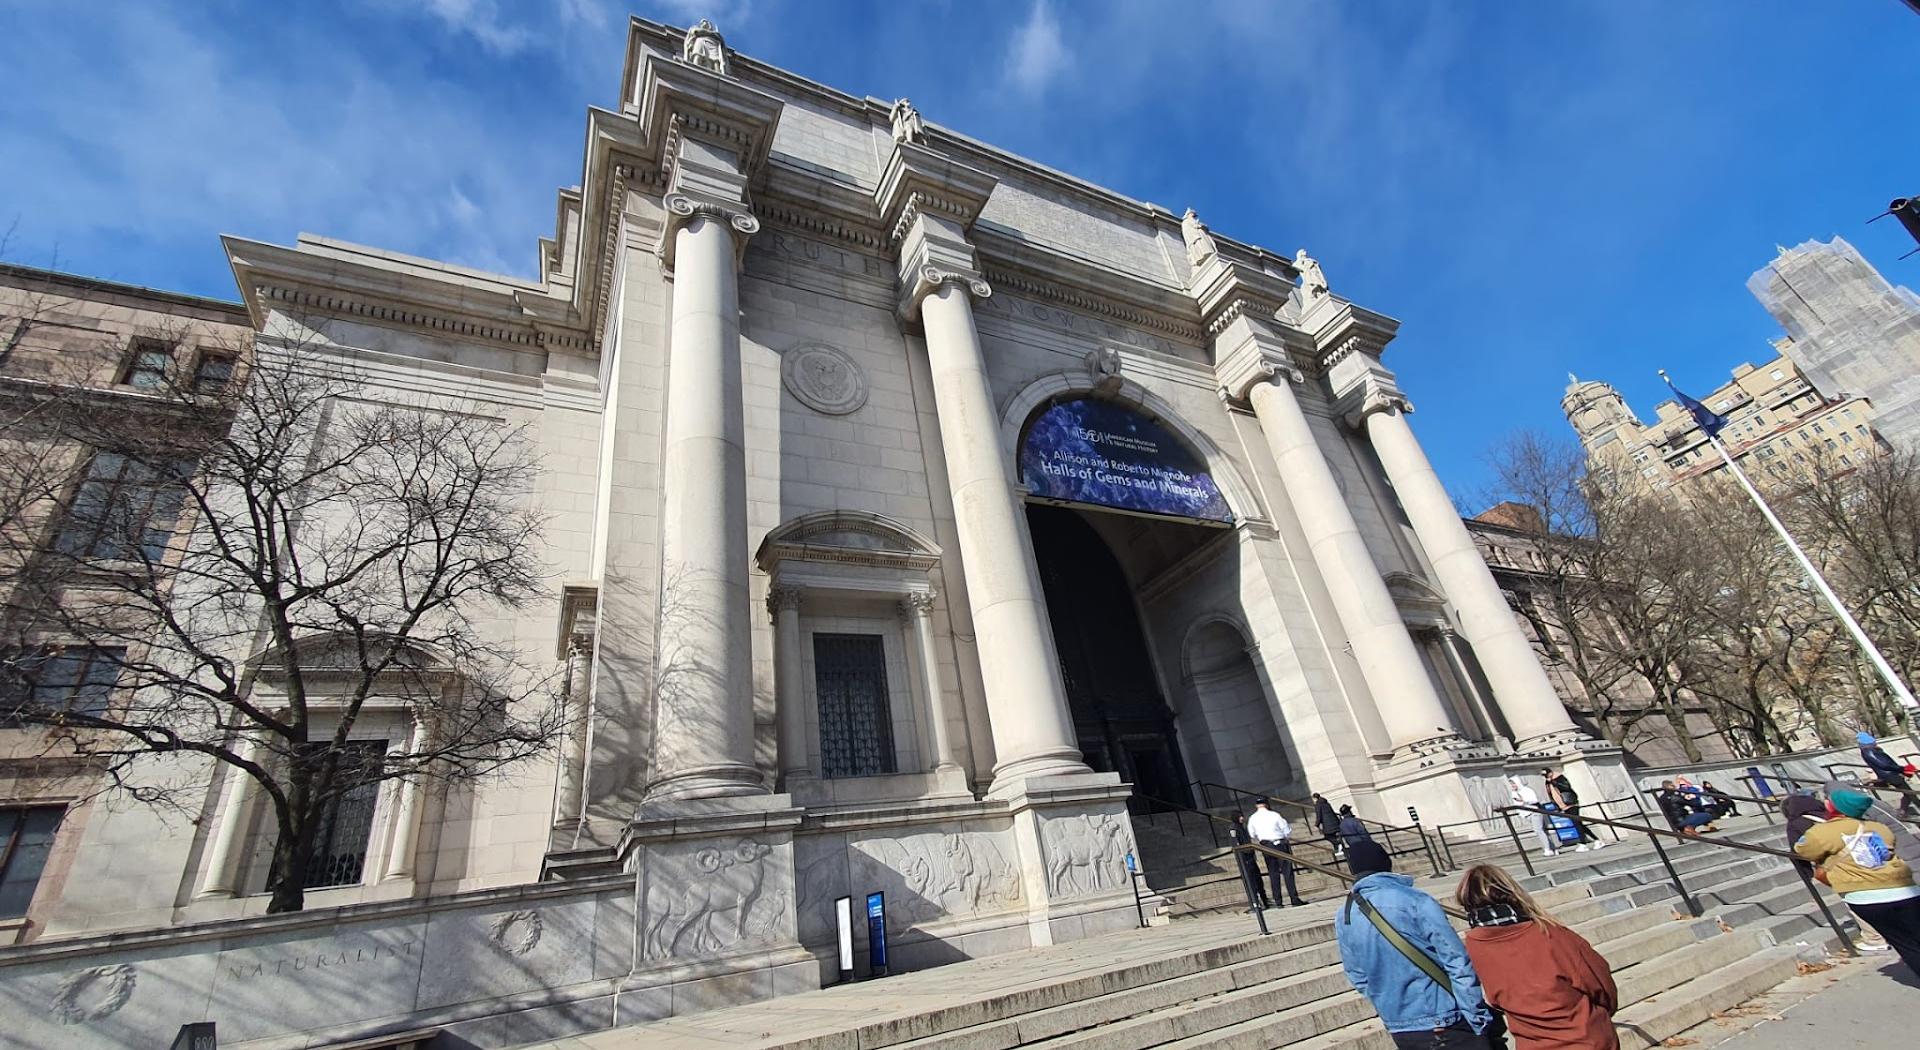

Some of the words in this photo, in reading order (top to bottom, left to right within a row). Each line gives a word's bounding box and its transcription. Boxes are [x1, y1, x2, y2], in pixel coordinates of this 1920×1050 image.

[772, 232, 883, 278] RUTH
[1041, 460, 1076, 478] Halls
[1079, 467, 1092, 480] of
[1095, 470, 1131, 486] Gems
[1134, 478, 1157, 491] and
[1159, 480, 1209, 499] Minerals
[1053, 450, 1089, 465] Allison
[1091, 457, 1109, 469] and
[1110, 459, 1149, 475] Roberto
[228, 941, 416, 980] NATURALIST
